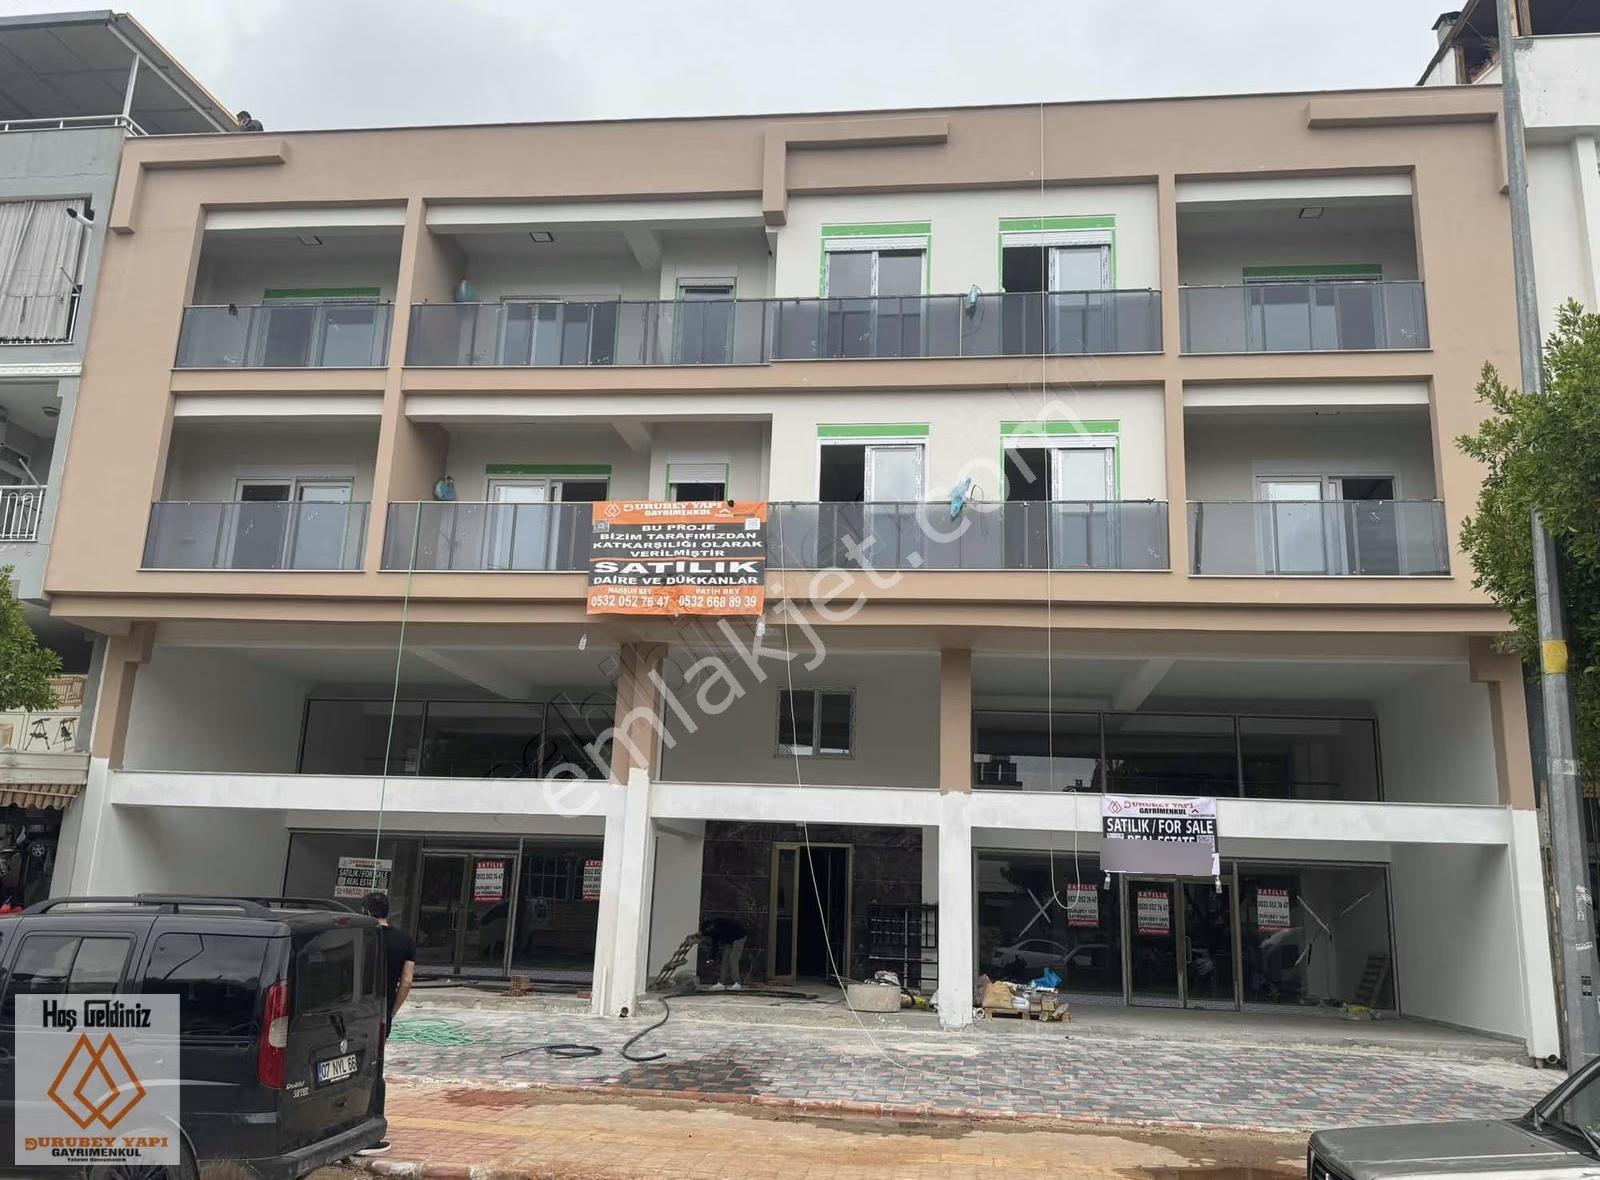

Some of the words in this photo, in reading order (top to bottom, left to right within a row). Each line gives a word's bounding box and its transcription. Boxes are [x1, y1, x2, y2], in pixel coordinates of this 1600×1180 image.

[600, 533, 642, 541] BİZİM
[647, 532, 756, 540] TARAFIMIZDAN
[593, 540, 697, 549] KATKARŞILIĞI
[701, 540, 762, 548] OLARAK
[630, 549, 725, 557] VERİLMİŞTİR
[594, 561, 758, 574] SATILIK
[593, 575, 637, 585] DAİRE
[642, 577, 662, 585] VE
[666, 574, 758, 585] DÜKKANLAR
[591, 595, 616, 607] 0532
[618, 595, 638, 607] 052
[640, 596, 654, 607] 76
[656, 596, 670, 607] 47
[679, 595, 704, 607] 0532
[706, 595, 726, 607] 668
[729, 595, 741, 607] 89
[744, 595, 757, 607] 39
[1107, 818, 1150, 833] SATILIK
[1158, 820, 1182, 834] FOR
[1186, 820, 1214, 834] SALE
[321, 1062, 330, 1078] 07
[333, 1060, 346, 1075] NYL
